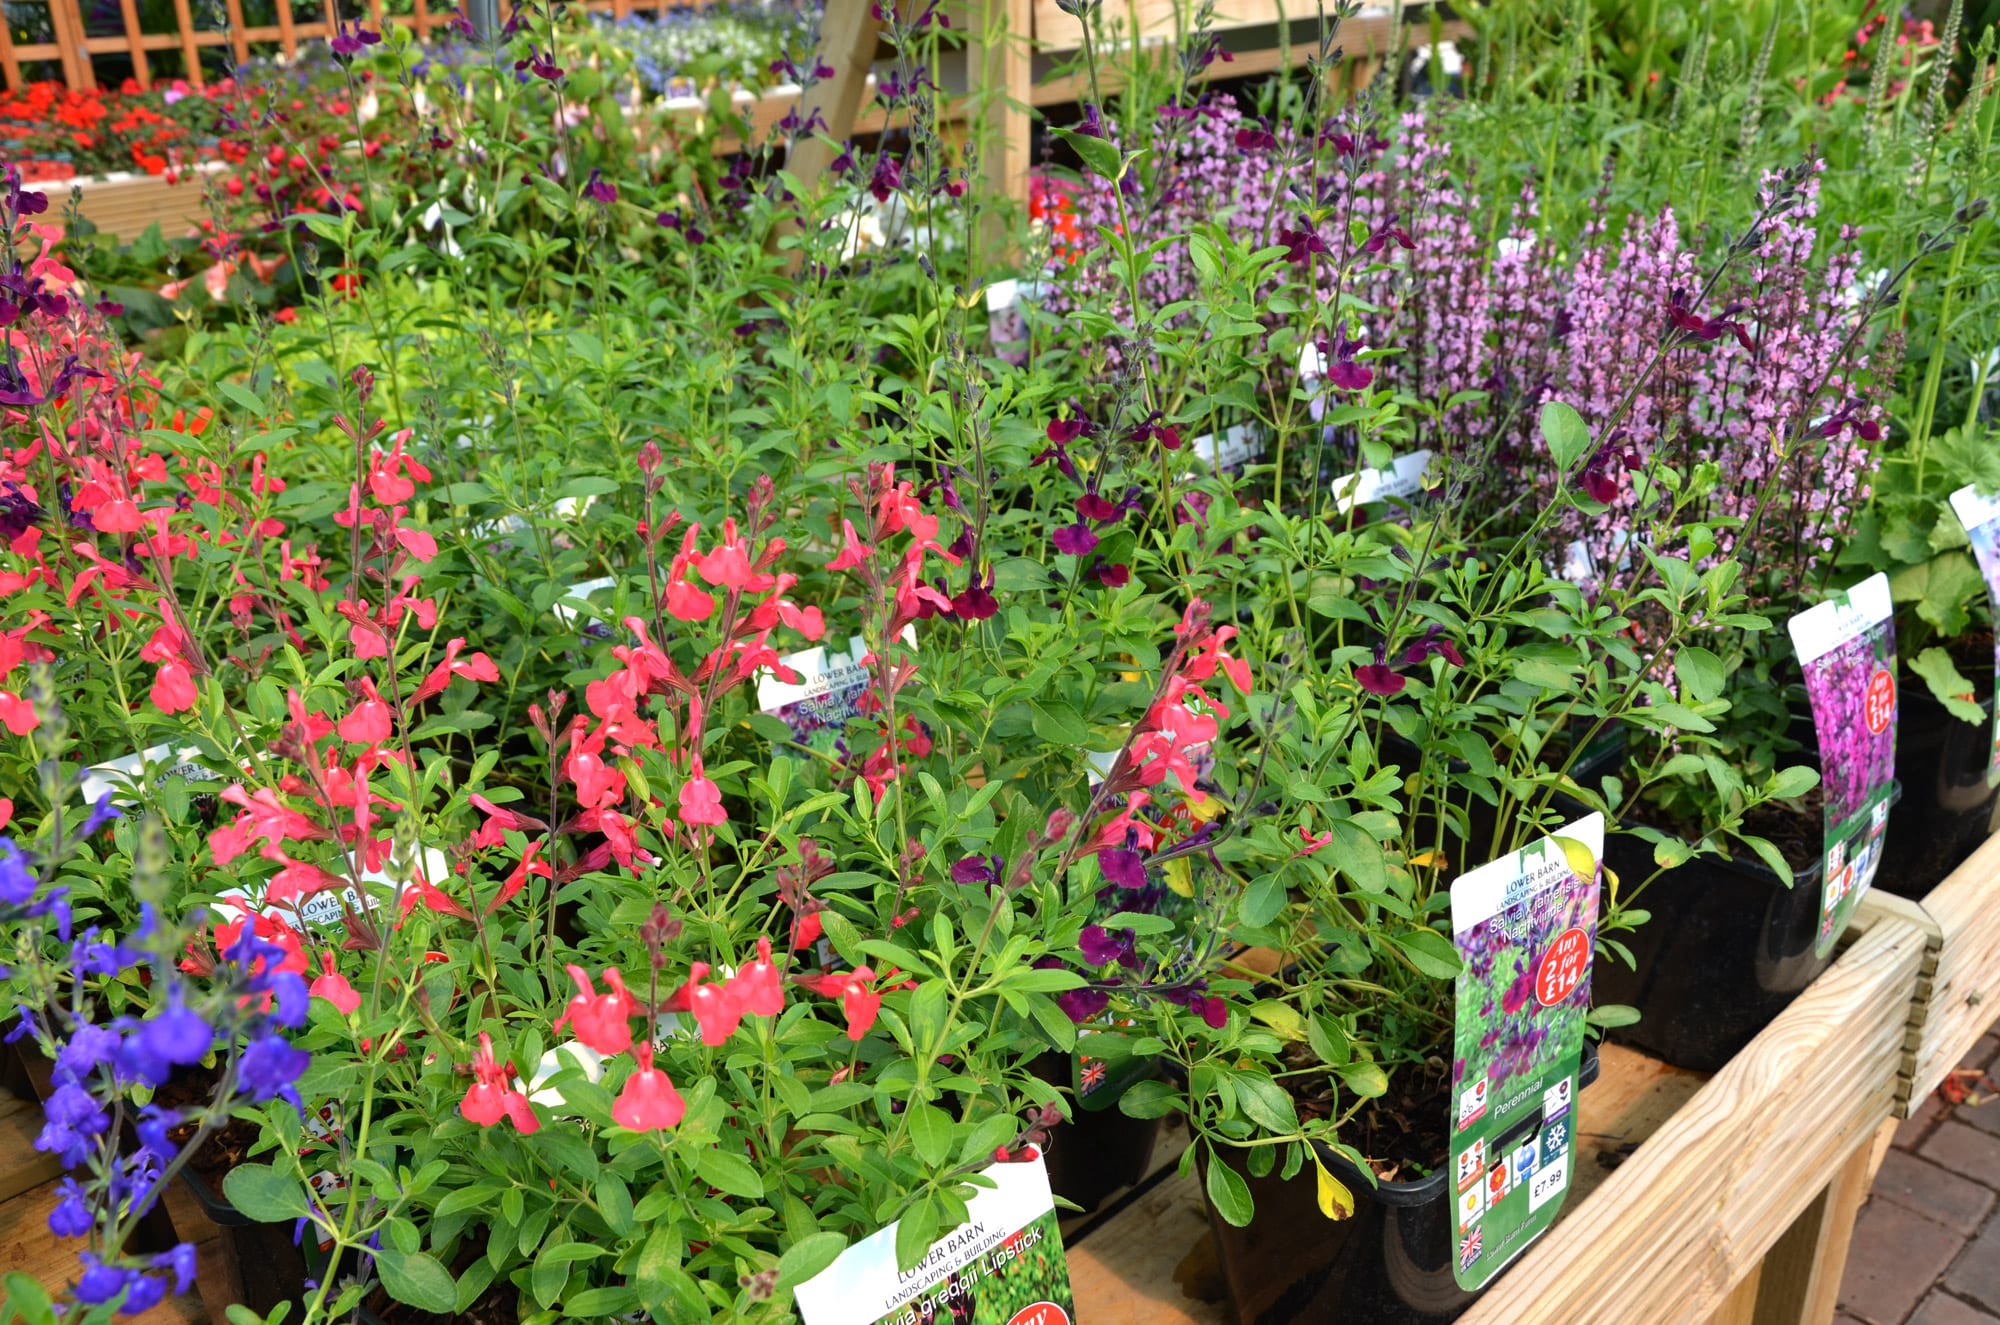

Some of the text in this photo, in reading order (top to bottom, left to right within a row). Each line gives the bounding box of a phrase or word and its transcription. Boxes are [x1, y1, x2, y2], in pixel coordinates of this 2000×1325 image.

[813, 669, 843, 684] LOWER
[1870, 695, 1878, 713] 2
[1872, 703, 1890, 730] £14
[1506, 859, 1560, 895] LOWER BARN
[301, 896, 341, 917] LOWE
[1496, 887, 1538, 911] LANDSCAPING
[1489, 909, 1525, 933] Salvia
[1552, 933, 1580, 959] Any
[1545, 950, 1581, 983] 2 for
[1545, 966, 1577, 1001] £14
[1494, 1076, 1544, 1119] Perennial
[1534, 1169, 1562, 1198] £7.99
[897, 1221, 985, 1284] LOWER BARN
[885, 1227, 1006, 1309] LANDSCAPING & BUILDING
[920, 1273, 979, 1318] greggii
[981, 1226, 1043, 1276] Lipstick
